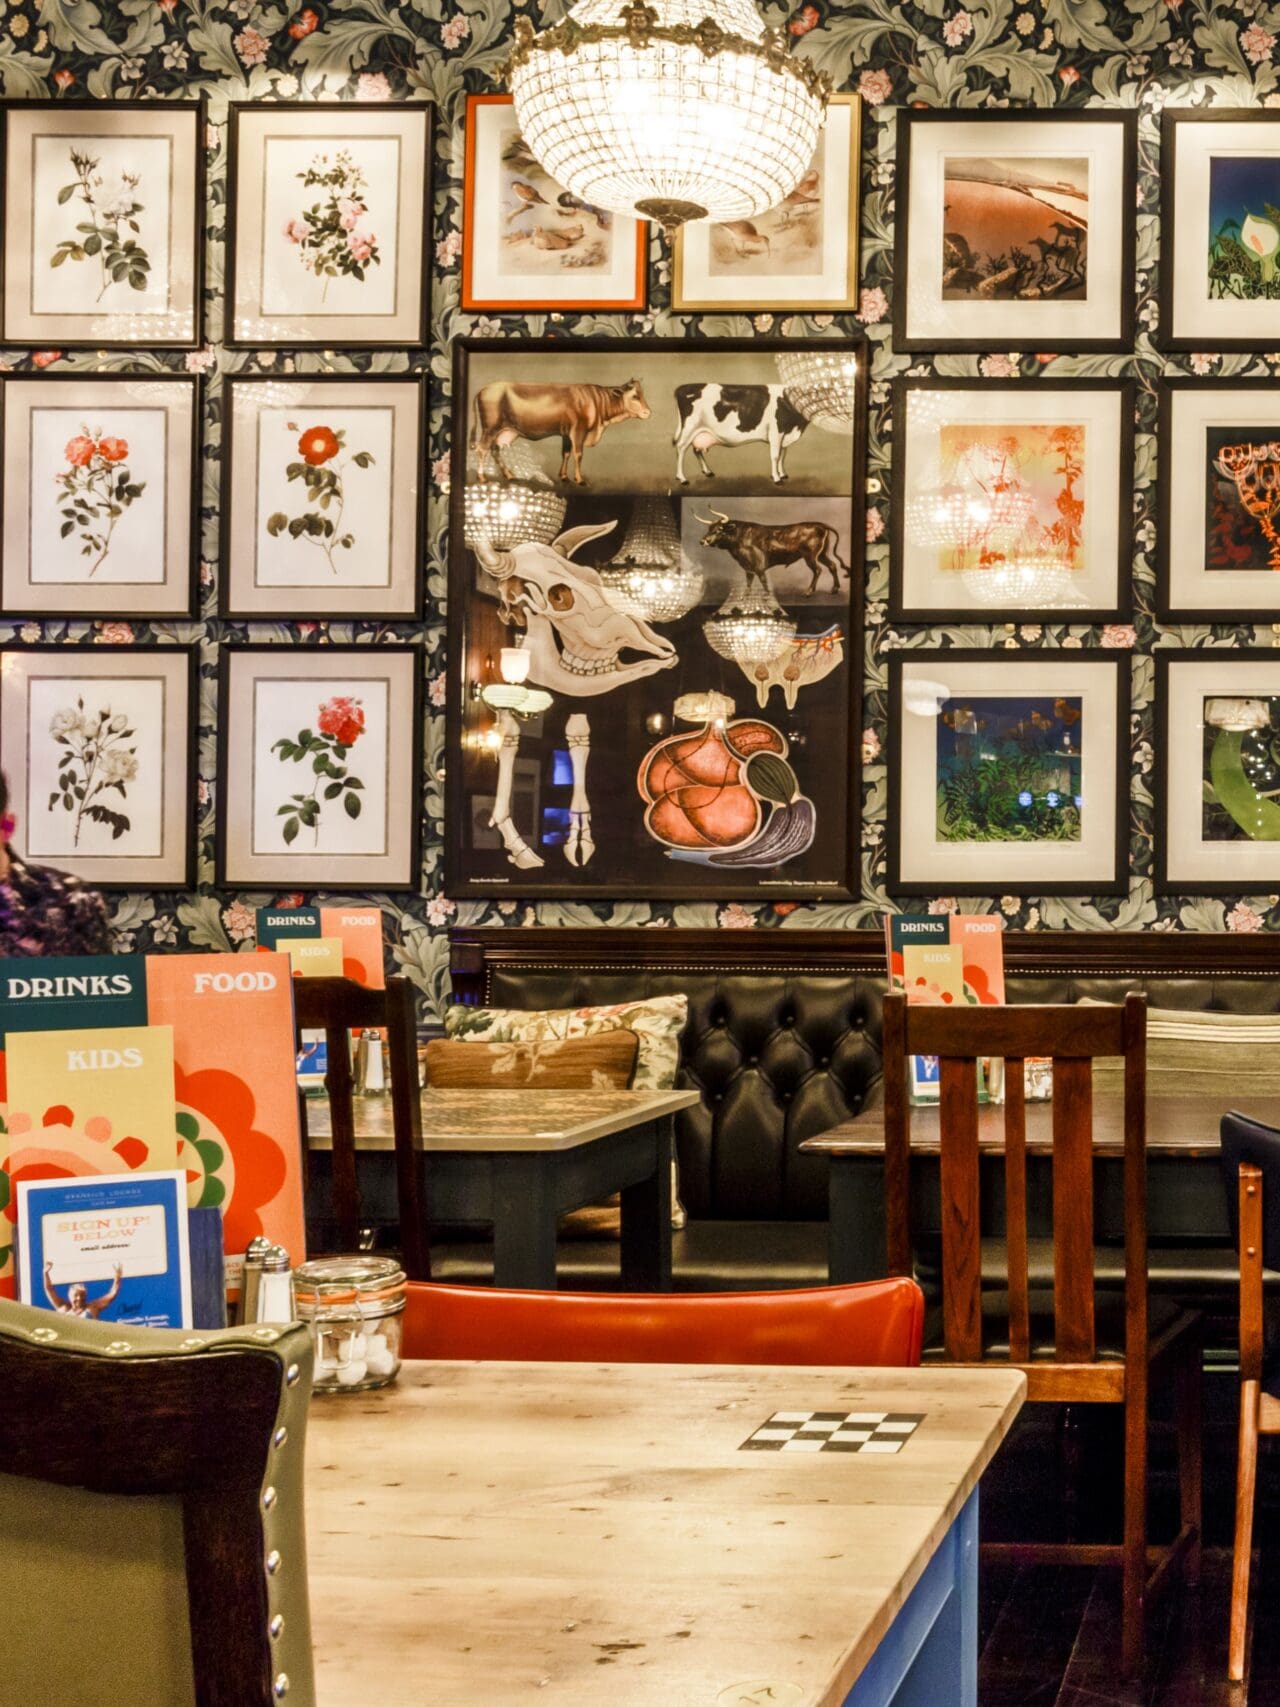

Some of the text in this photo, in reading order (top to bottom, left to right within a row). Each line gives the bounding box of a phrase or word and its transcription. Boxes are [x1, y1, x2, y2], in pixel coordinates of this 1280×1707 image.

[267, 916, 316, 926] DRINKS
[341, 916, 377, 926] FOOD
[900, 922, 945, 932] DRINKS
[964, 922, 996, 933] FOOD
[7, 974, 133, 999] DRINKS
[193, 972, 277, 993] FOOD
[67, 1047, 143, 1071] KIDS
[57, 1218, 110, 1233] SIGN
[74, 1228, 136, 1242] BELOW
